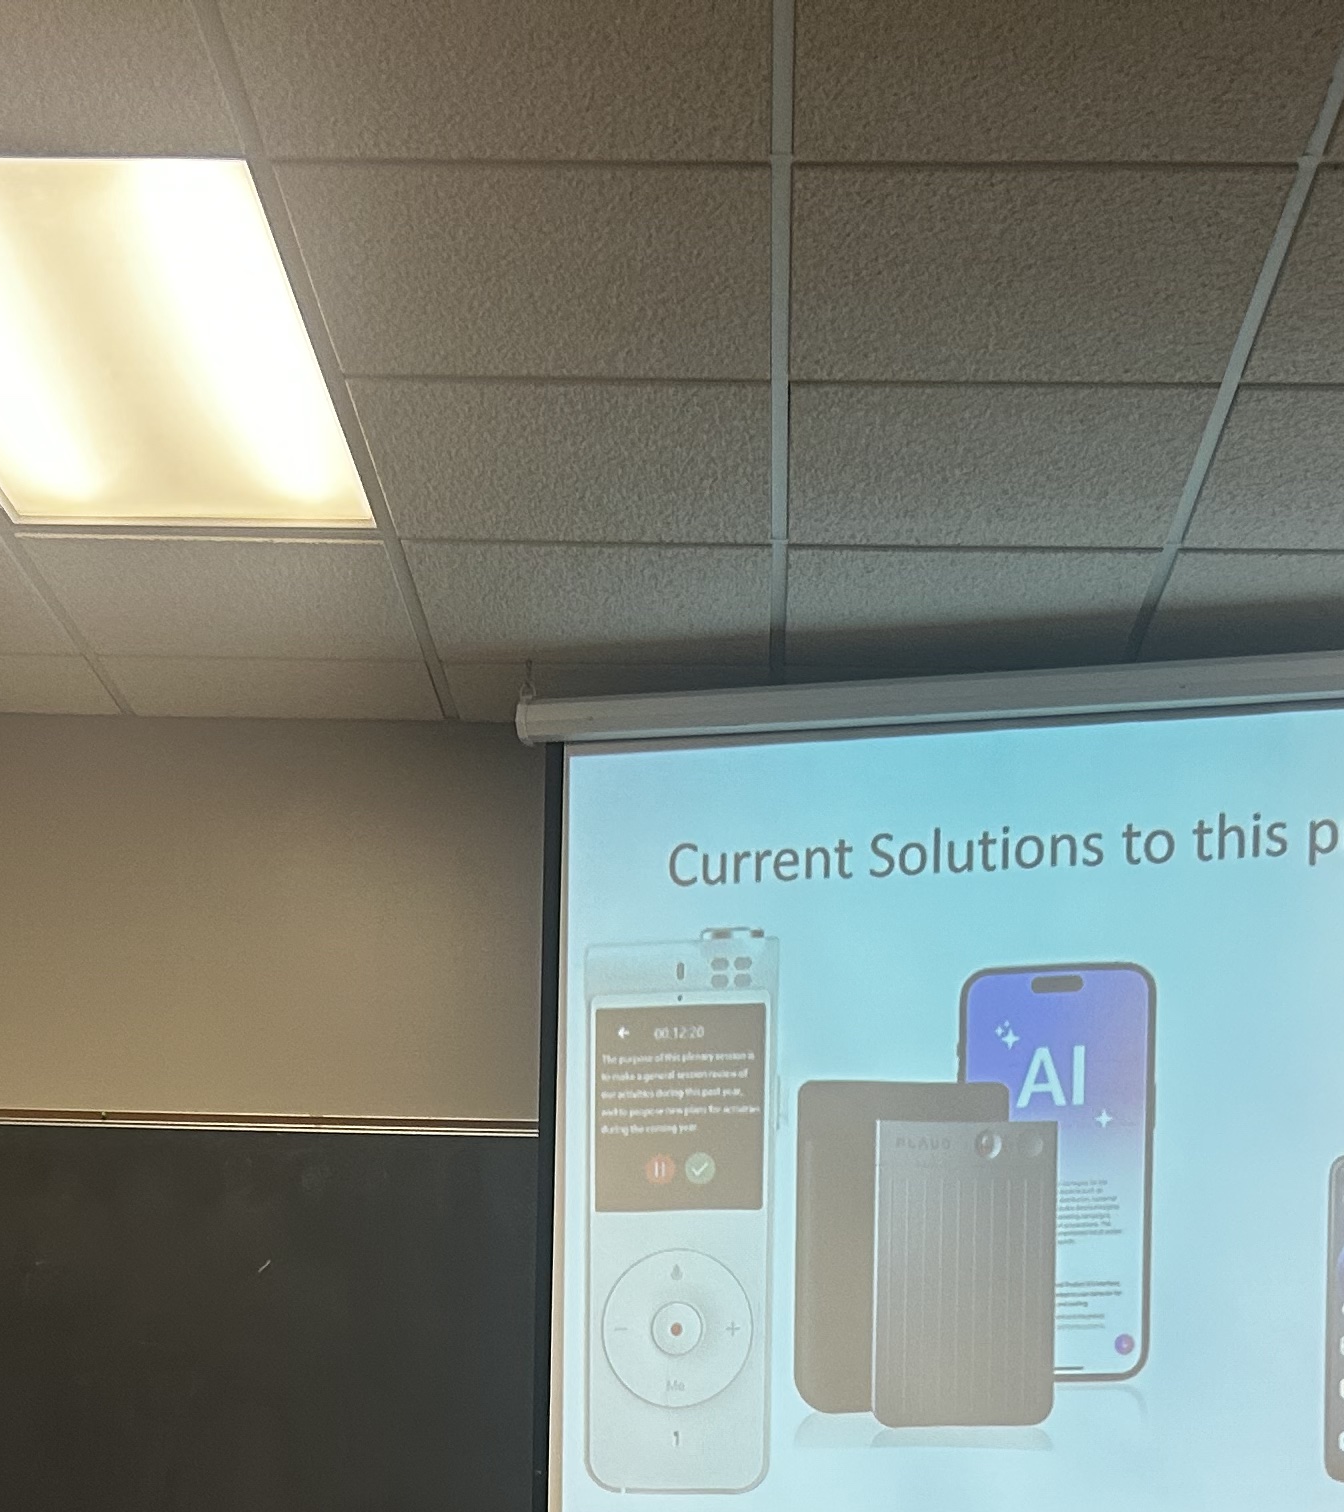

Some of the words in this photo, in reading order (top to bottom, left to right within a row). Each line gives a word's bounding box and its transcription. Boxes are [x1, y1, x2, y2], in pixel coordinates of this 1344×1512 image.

[668, 838, 854, 887] Current
[869, 826, 1104, 878] Solutions
[1122, 823, 1175, 865] to
[1192, 812, 1288, 862] this
[1016, 1045, 1086, 1108] AI
